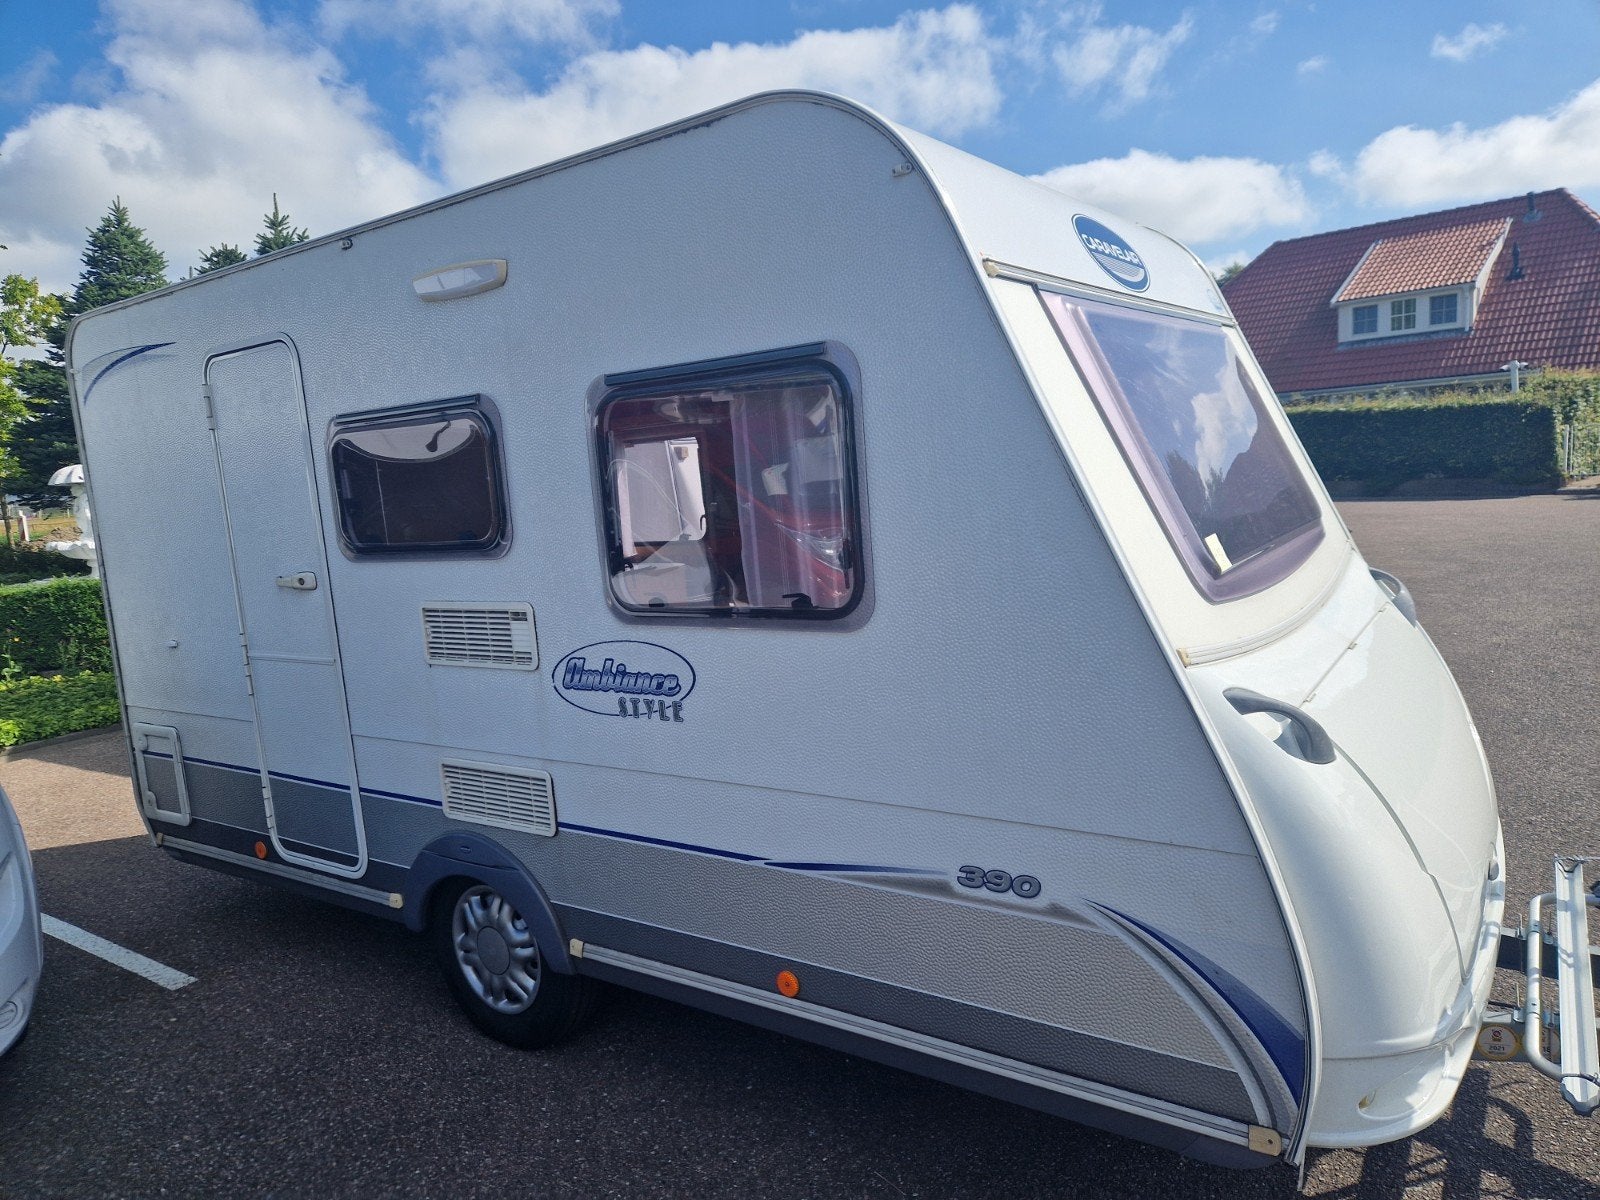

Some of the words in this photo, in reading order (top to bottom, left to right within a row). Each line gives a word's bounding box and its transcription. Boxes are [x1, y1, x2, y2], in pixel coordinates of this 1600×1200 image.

[563, 657, 681, 696] Ambiance
[617, 697, 684, 722] STYLE
[957, 865, 1041, 898] 390
